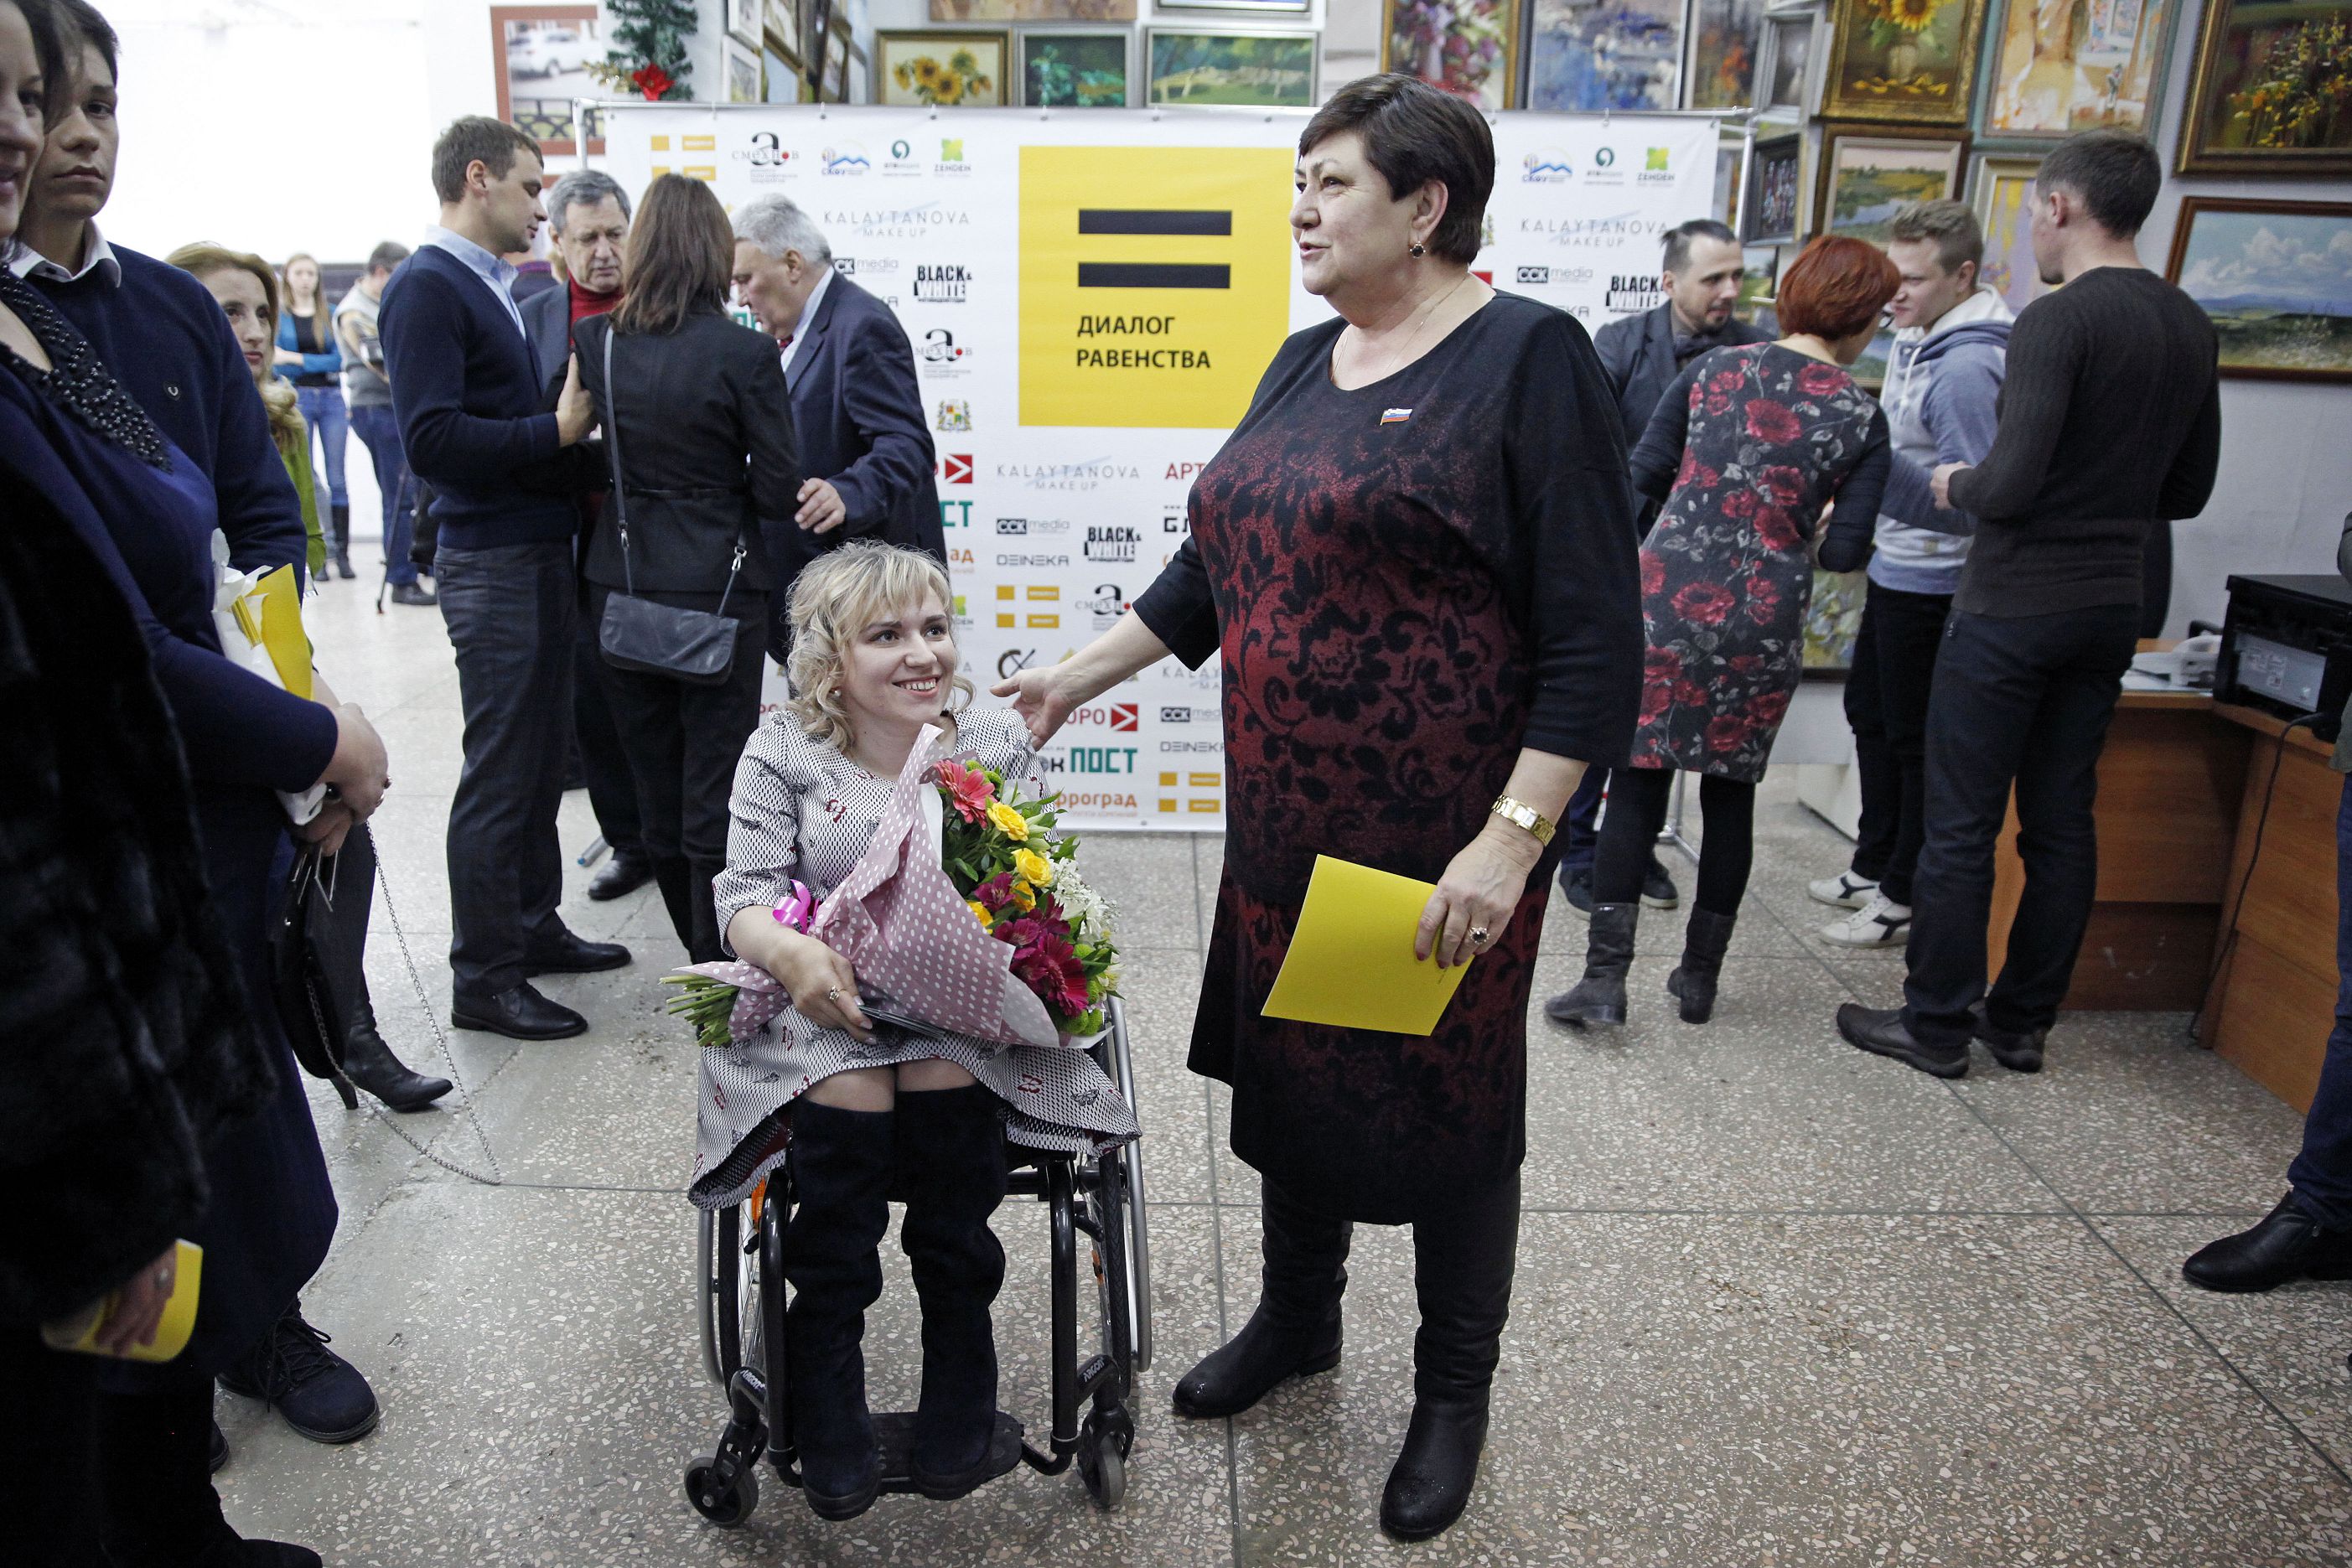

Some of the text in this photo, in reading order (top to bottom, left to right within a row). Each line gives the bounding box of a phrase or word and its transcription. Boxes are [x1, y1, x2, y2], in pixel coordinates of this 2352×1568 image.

[824, 210, 970, 224] KALAYTANOVA
[863, 227, 927, 237] MAKE UP
[1521, 218, 1668, 234] KALAYTANOVA
[1559, 236, 1625, 247] MAKE UP
[1517, 266, 1593, 282] CCK media
[1611, 276, 1663, 292] BLACK
[1076, 315, 1175, 337] ДИАЛОГ
[1076, 349, 1211, 369] РАВЕНСТВА
[997, 464, 1140, 479] KALAYTANOVA
[1035, 481, 1099, 490] MAKE UP
[997, 518, 1070, 534] CCK media
[997, 554, 1070, 566] DEINEKA
[1161, 707, 1191, 722] CCK
[1070, 748, 1138, 773] ПОСТ
